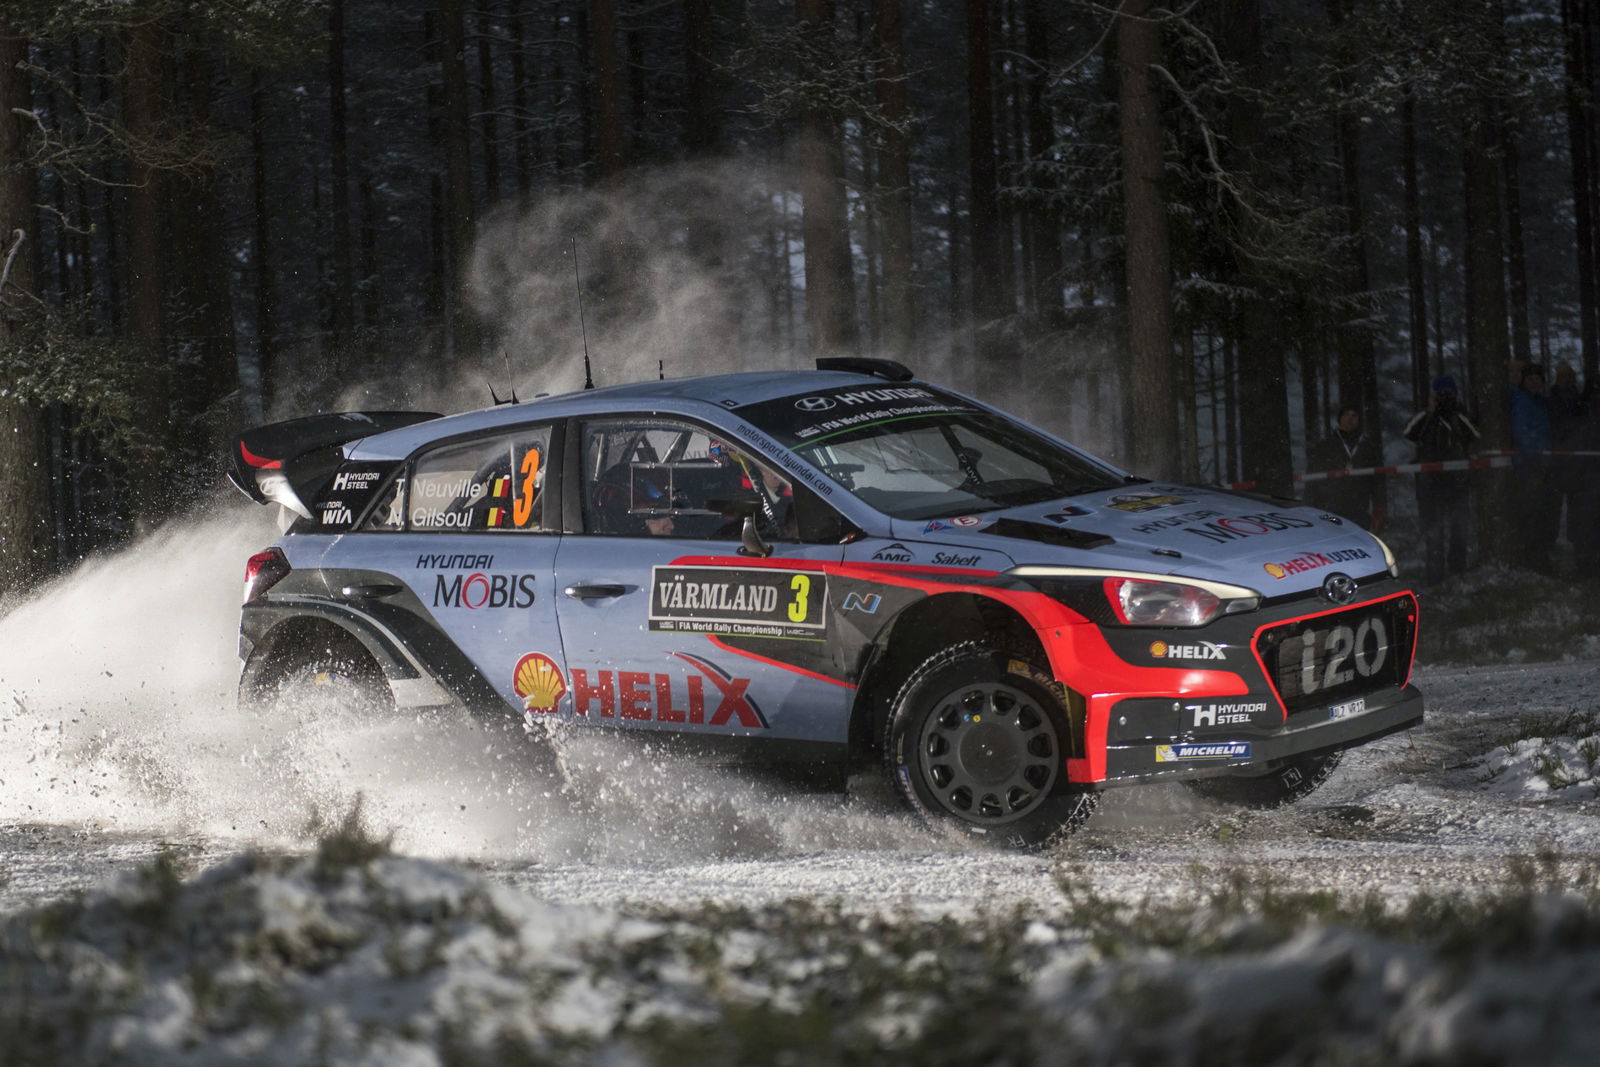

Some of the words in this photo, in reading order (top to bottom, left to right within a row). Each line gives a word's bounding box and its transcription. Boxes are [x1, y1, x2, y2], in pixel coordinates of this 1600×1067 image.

[822, 418, 841, 431] FIA
[838, 412, 868, 426] World
[866, 408, 894, 421] Rally
[889, 404, 949, 417] Championship
[736, 423, 834, 496] motorsport.hyundai.com
[346, 481, 369, 490] STEEL
[349, 473, 380, 481] HYUNDAI
[413, 480, 481, 498] Neuville
[513, 449, 540, 527] 3
[412, 508, 474, 527] Gilsoul
[1183, 512, 1314, 544] MOBIS
[416, 554, 494, 569] HYUNDAI
[871, 552, 911, 563] AMG
[930, 551, 982, 567] Sabelt
[1284, 551, 1336, 576] HELIX
[1332, 548, 1372, 563] ULTRA
[433, 573, 536, 610] MOBIS
[659, 574, 778, 613] VÄRMLAND
[787, 574, 811, 623] 3
[679, 621, 691, 631] FIA
[691, 622, 713, 632] World
[713, 623, 732, 634] Rally
[732, 624, 783, 636] Championship
[1168, 641, 1226, 660] HELIX
[1301, 617, 1388, 695] i20
[569, 651, 770, 729] HELIX
[1217, 703, 1267, 714] HYUNDAI
[1217, 714, 1251, 724] STEEL
[1178, 745, 1246, 757] MICHELIN
